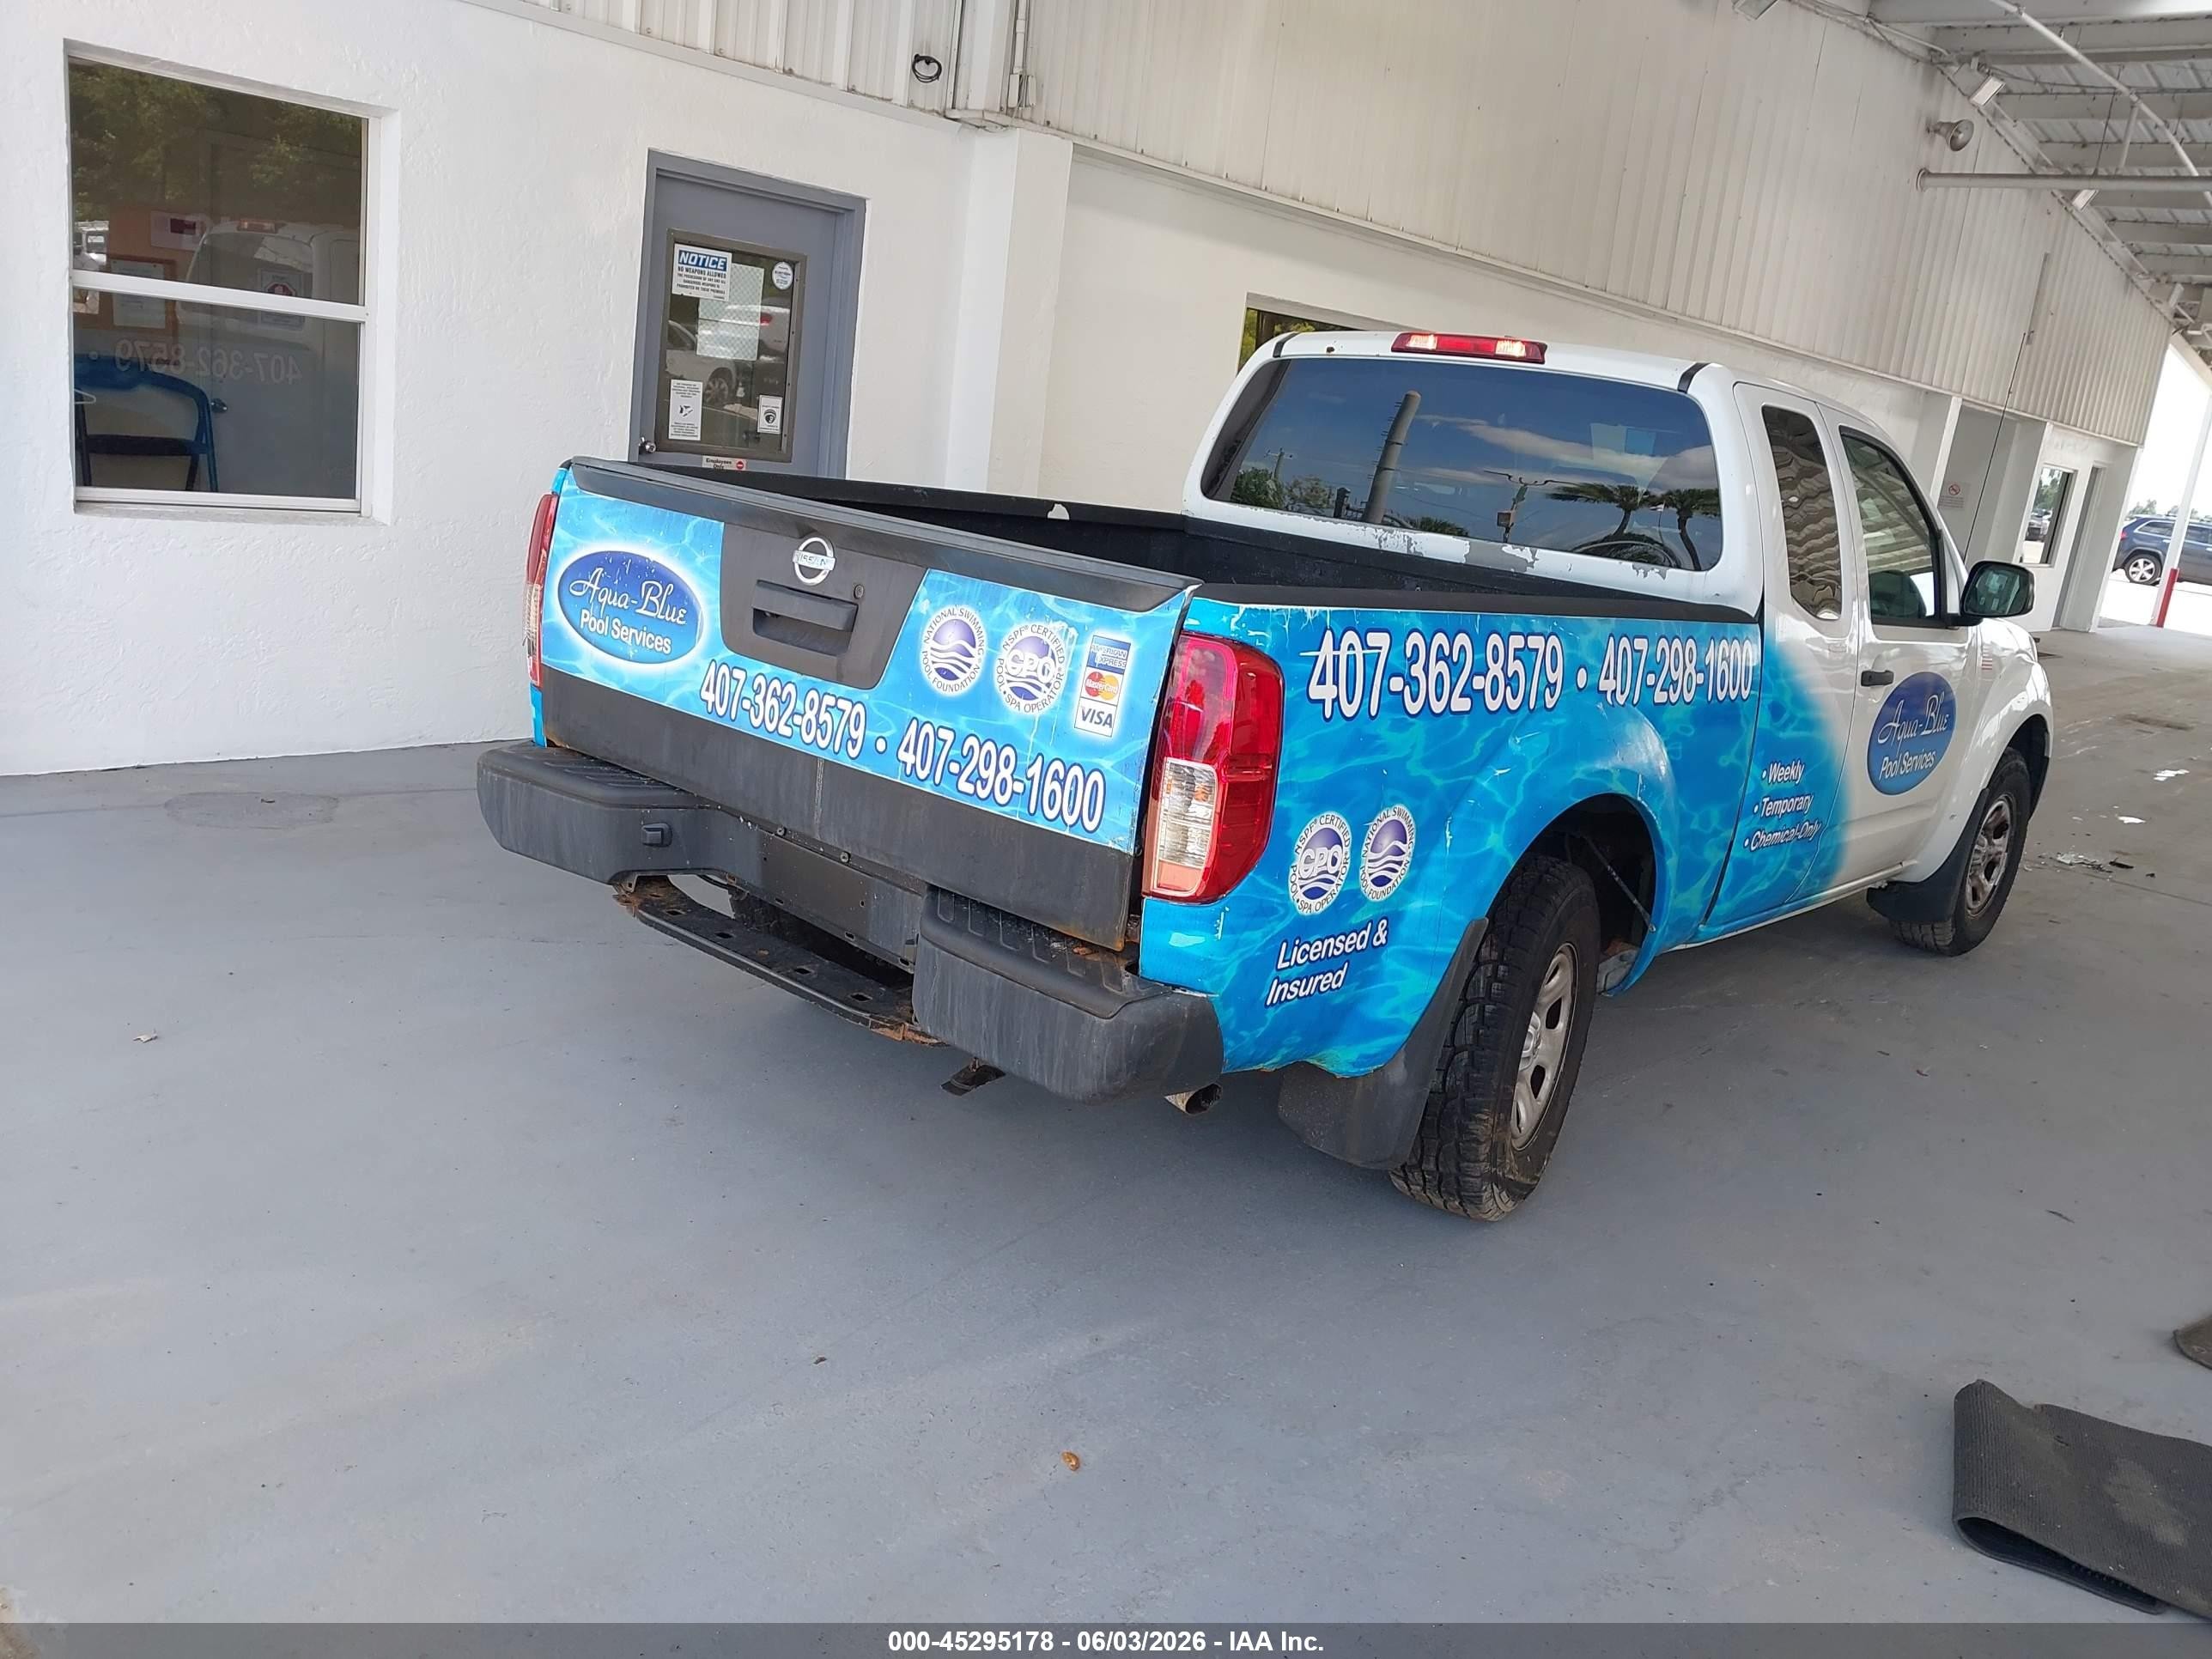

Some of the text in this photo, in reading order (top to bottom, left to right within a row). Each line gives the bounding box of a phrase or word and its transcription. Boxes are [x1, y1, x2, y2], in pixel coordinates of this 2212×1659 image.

[678, 251, 727, 270] NOTICE
[684, 267, 706, 276] WEAPONS
[707, 270, 726, 279] ALLOWED
[569, 567, 688, 625] Aqua-Blue
[580, 609, 672, 655] Pool Services
[923, 607, 985, 656] NATIONAL SWIMMING
[1030, 623, 1066, 665] CERTIFIED
[921, 650, 981, 693] POOL FOUNDATION
[997, 658, 1006, 692] POOL
[1005, 693, 1021, 712] SPA
[1308, 629, 1754, 720] 407-362-8579 407-298-1600
[1081, 707, 1114, 730] VISA
[1877, 690, 1950, 757] Aqua-Blue
[699, 659, 1107, 834] 407-362-8579 407-298-1600
[1878, 748, 1937, 781] Pool Services
[1768, 759, 1805, 785] Weekly
[1760, 794, 1814, 819] Temporary
[1320, 814, 1351, 848] CERTIFIED
[1361, 806, 1415, 859] NATIONAL SWIMMING
[1750, 819, 1822, 852] Chemical-Only
[1291, 864, 1299, 902] POOL
[1297, 899, 1313, 914] SPA
[1360, 860, 1410, 901] POOL FOUNDATION
[1276, 918, 1389, 970] Licensed &
[1265, 961, 1349, 1006] Insured
